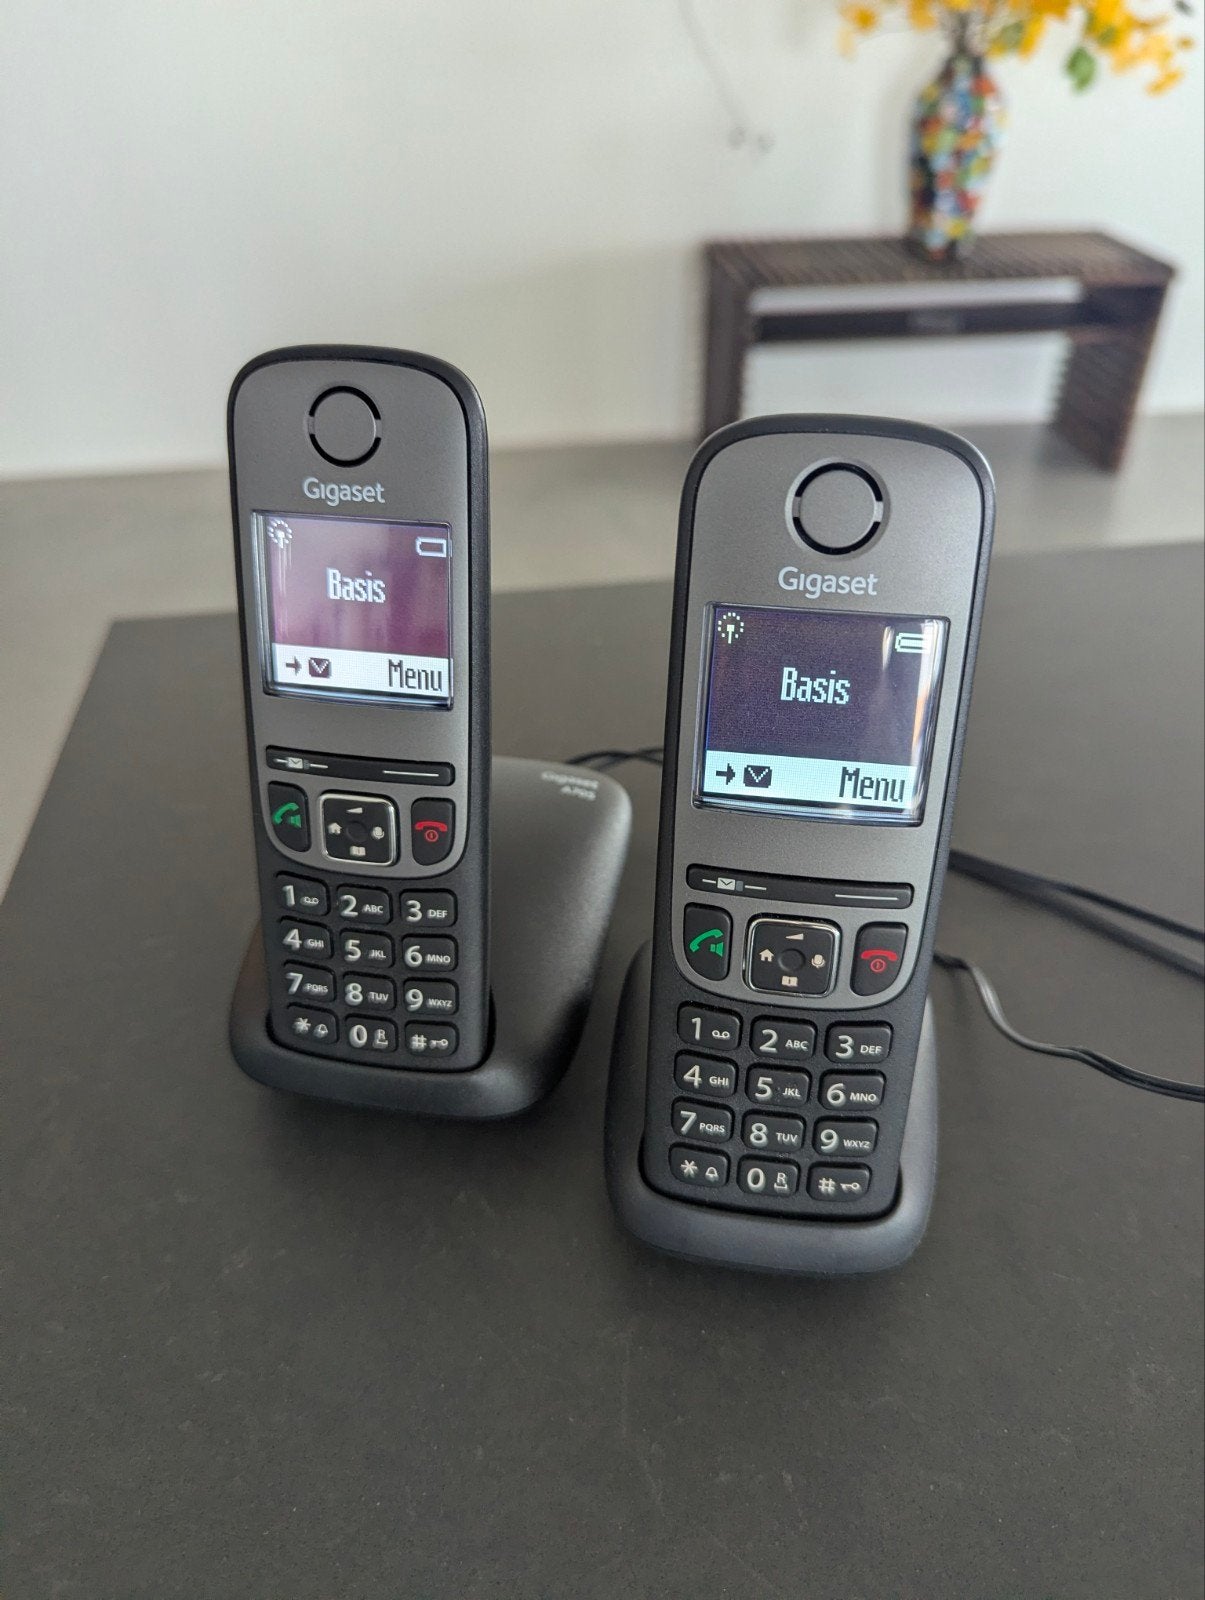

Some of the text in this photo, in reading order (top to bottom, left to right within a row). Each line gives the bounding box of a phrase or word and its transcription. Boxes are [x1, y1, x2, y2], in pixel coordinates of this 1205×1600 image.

[303, 476, 385, 506] Gigaset
[326, 567, 386, 603] Basis
[778, 566, 878, 599] Gigaset
[388, 659, 442, 691] Menu
[780, 667, 850, 704] Basis
[839, 767, 905, 802] Menu
[282, 885, 295, 906] 1
[340, 895, 384, 917] 2 ABC
[405, 900, 448, 922] 3 DEF
[282, 929, 324, 950] 4 GHI
[344, 939, 386, 962] 5 JKL
[405, 946, 450, 967] 6 MNO
[285, 972, 328, 995] 7 PQRS
[345, 983, 389, 1006] 8 TUV
[405, 989, 452, 1012] 9 WXYZ
[350, 1024, 367, 1047] 0
[691, 1017, 701, 1041] 1
[759, 1029, 808, 1053] 2 ABC
[835, 1035, 882, 1059] 3 DEF
[683, 1065, 729, 1089] 4 GHI
[755, 1077, 801, 1100] 5 JKL
[827, 1083, 877, 1106] 6 MNO
[680, 1110, 725, 1135] 7 PQRS
[750, 1123, 798, 1147] 8 TUV
[820, 1129, 871, 1152] 9 WXYZ
[747, 1167, 765, 1192] 0
